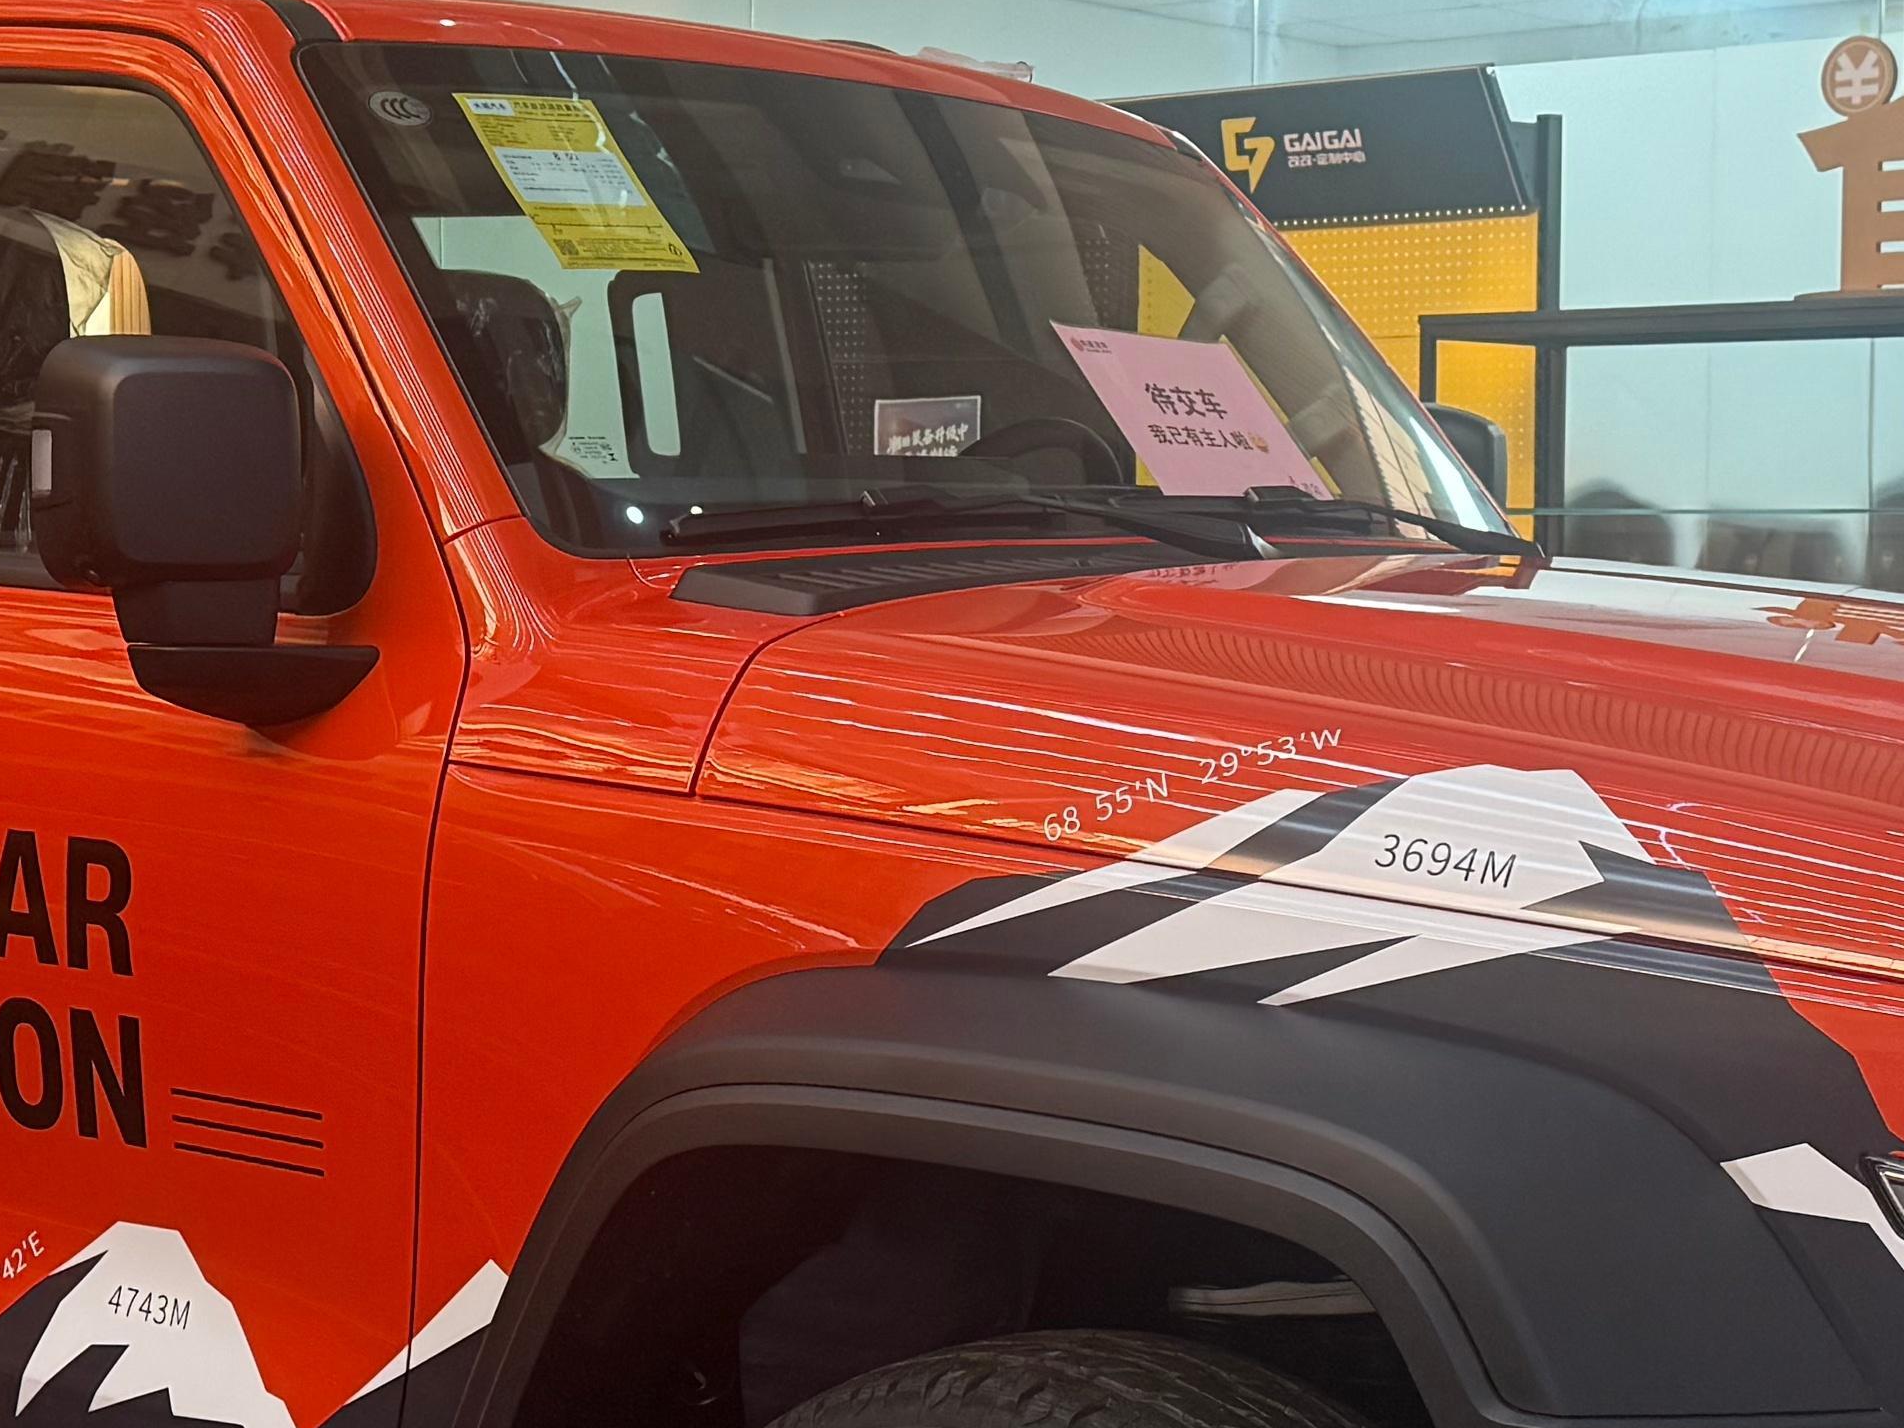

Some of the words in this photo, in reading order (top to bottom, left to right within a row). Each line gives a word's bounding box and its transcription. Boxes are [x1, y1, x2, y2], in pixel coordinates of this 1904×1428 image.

[1283, 128, 1363, 153] GAIGAI
[1145, 382, 1228, 420] 待交车
[1147, 423, 1254, 451] 我已有主人啦
[1199, 728, 1342, 785] 29°53'W
[1373, 832, 1516, 891] 3694M
[107, 1284, 192, 1332] 4743M
